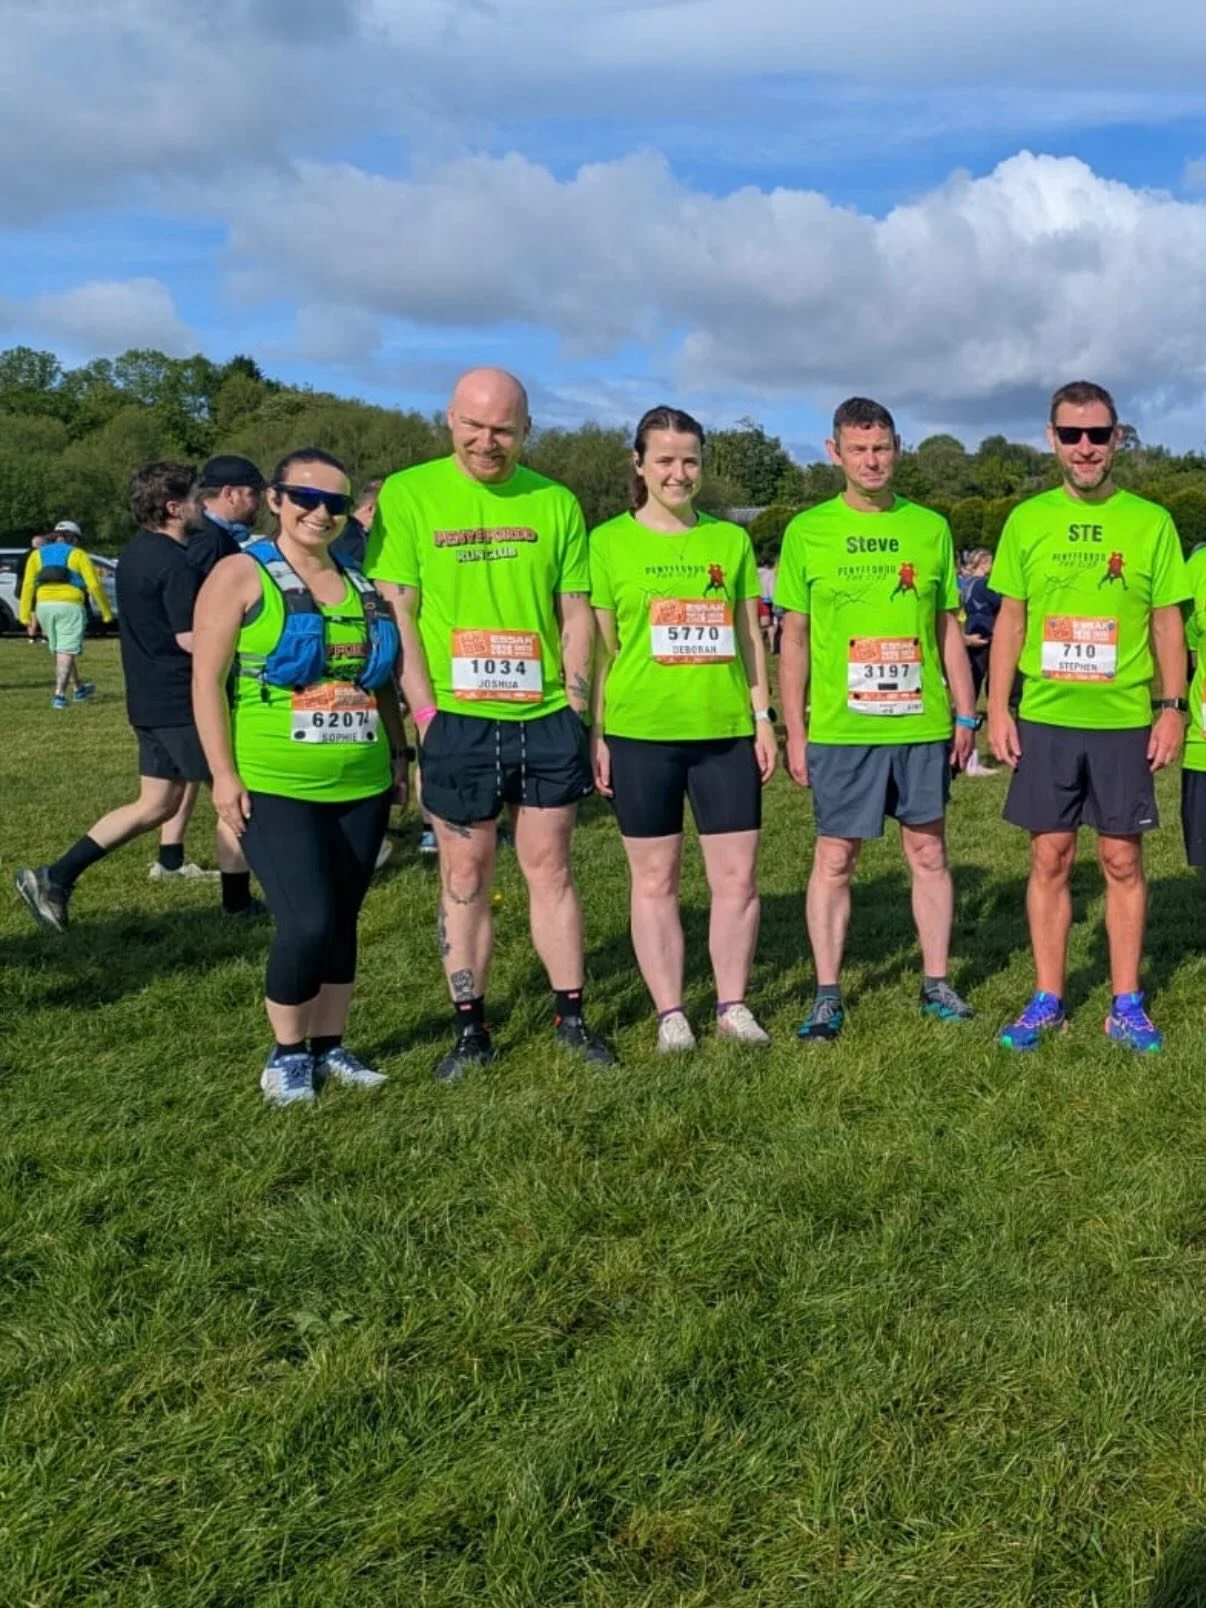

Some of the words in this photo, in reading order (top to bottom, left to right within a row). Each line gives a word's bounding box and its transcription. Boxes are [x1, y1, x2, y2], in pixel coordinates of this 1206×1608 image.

[1068, 523, 1103, 542] STE
[846, 535, 900, 554] Steve
[667, 626, 720, 641] 5770
[671, 645, 717, 654] DEBORAH
[1063, 643, 1097, 659] 710
[471, 659, 527, 676] 1034
[863, 663, 910, 679] 3197
[1059, 661, 1098, 672] STEPHEN
[478, 679, 519, 689] JOSHUA
